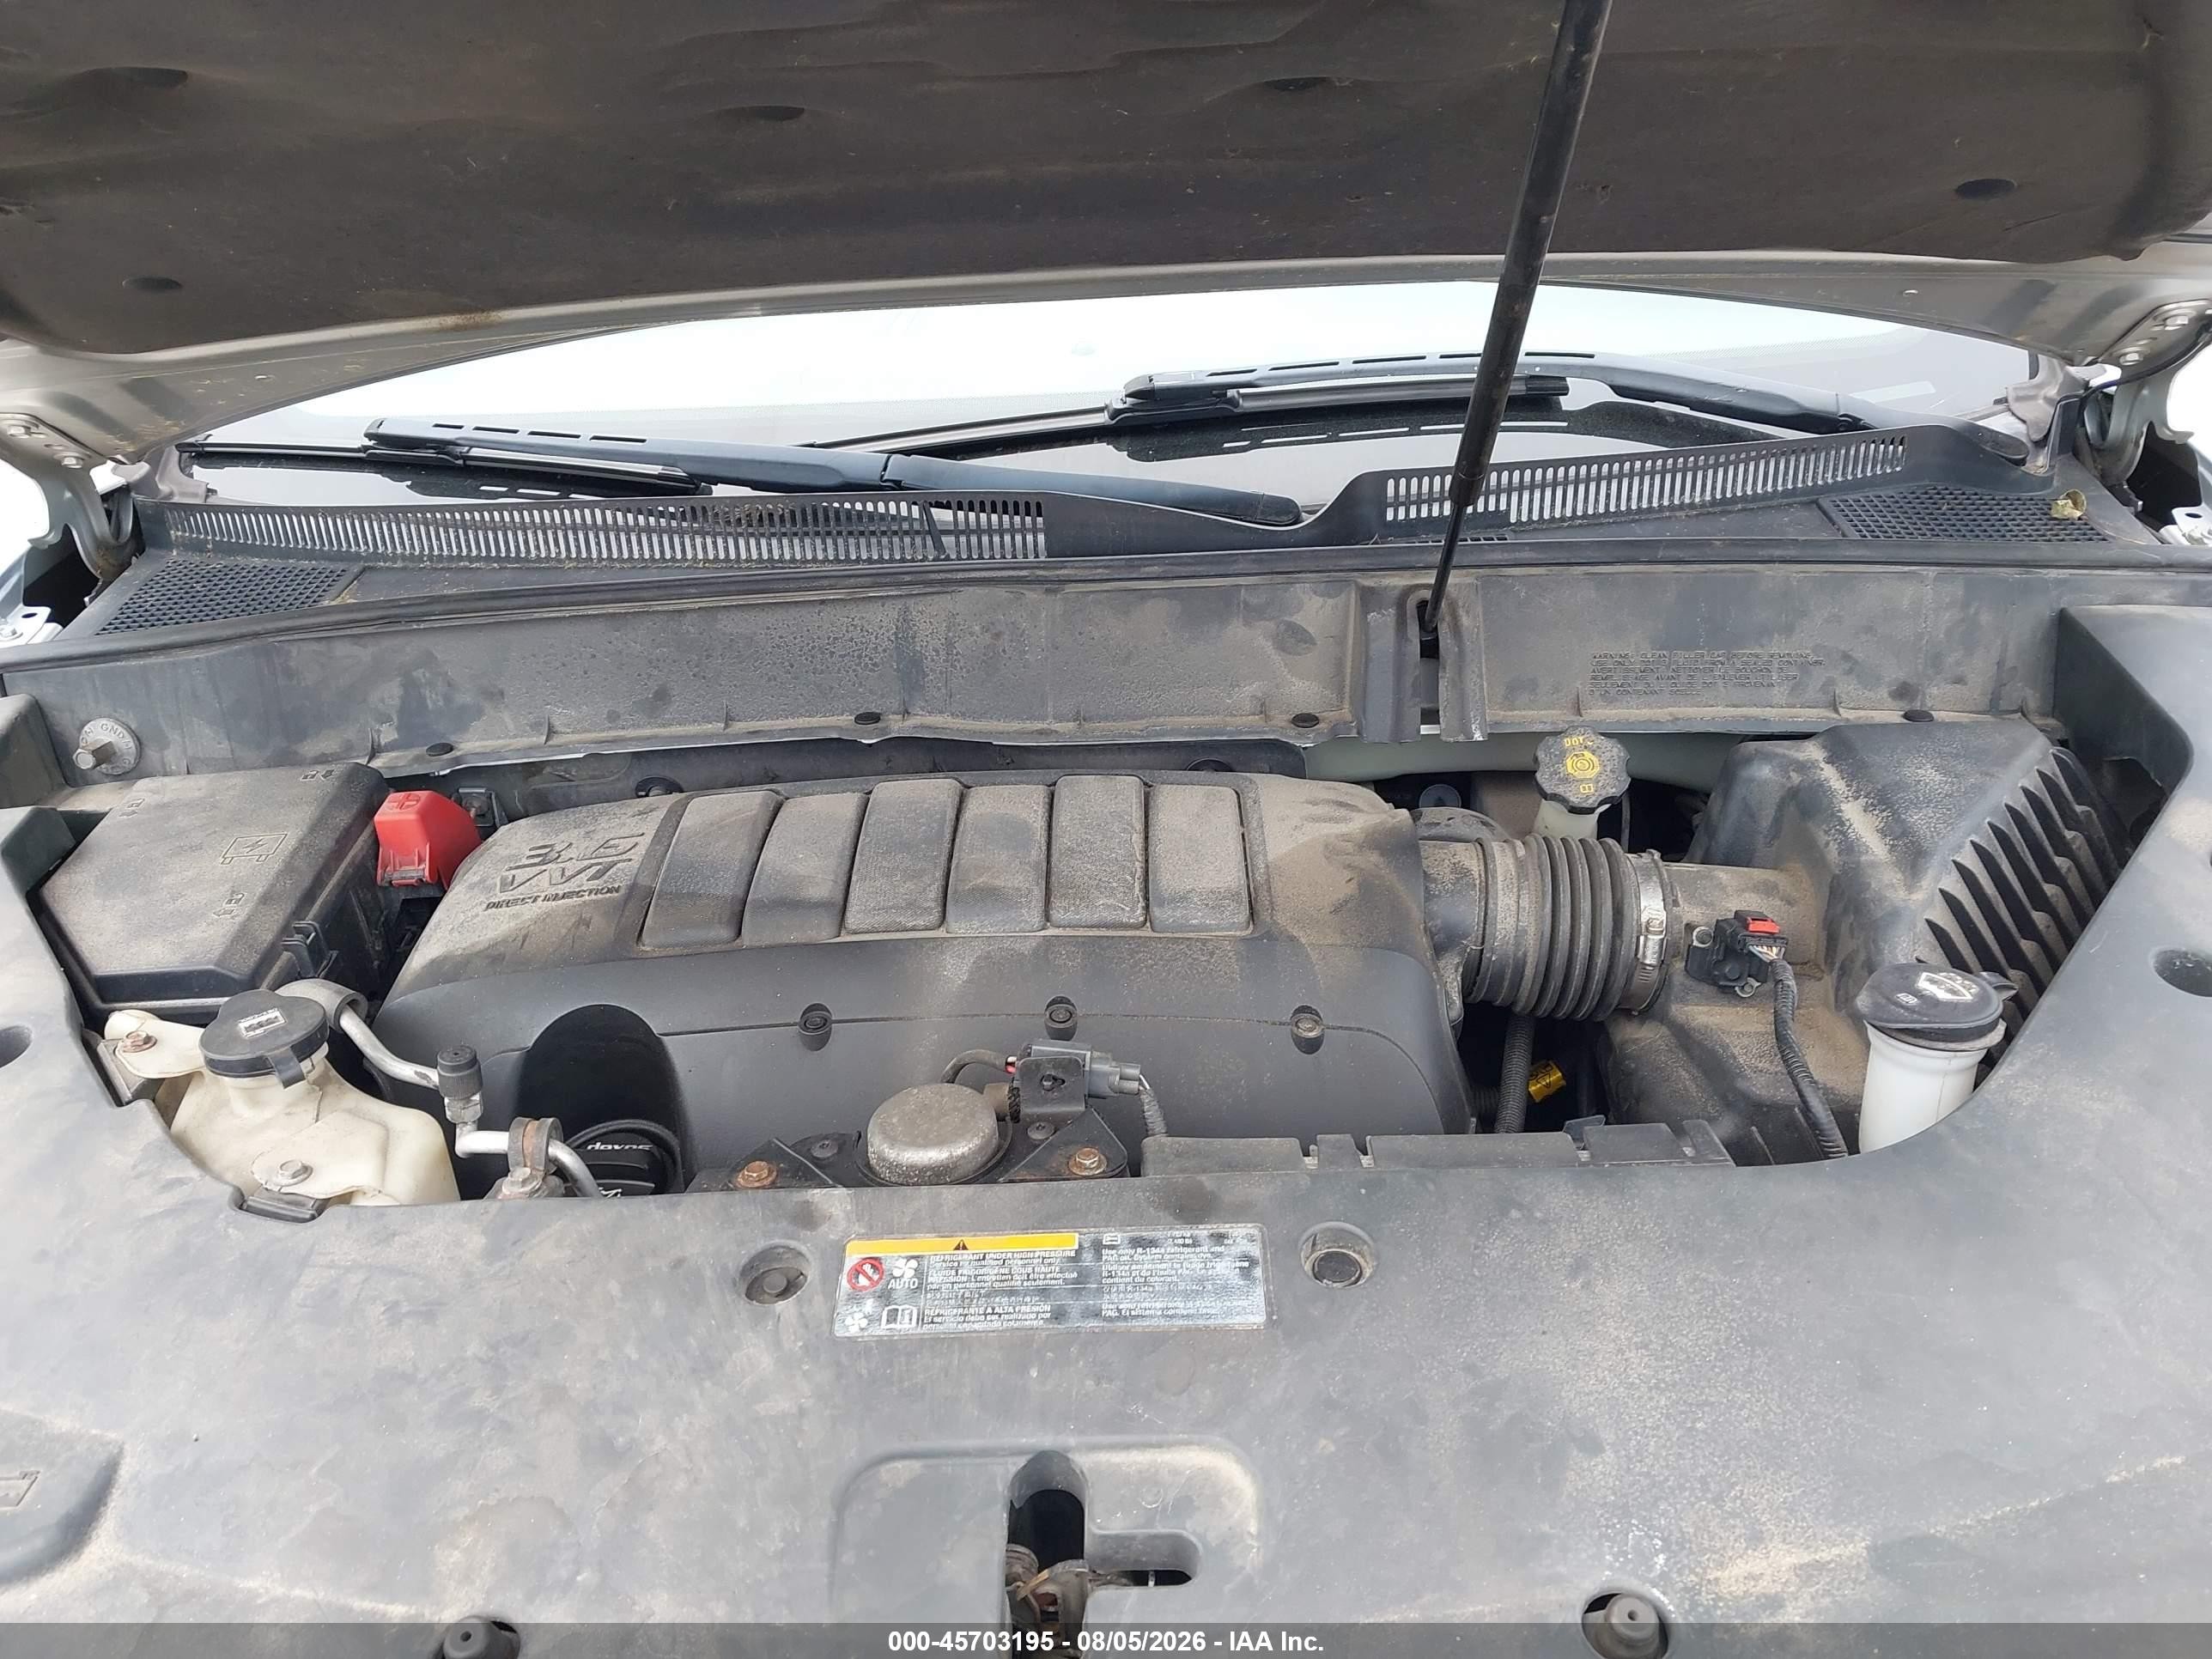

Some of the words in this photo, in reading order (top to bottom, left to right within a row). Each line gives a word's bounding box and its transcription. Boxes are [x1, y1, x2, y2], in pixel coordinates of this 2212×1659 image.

[1565, 737, 1584, 746] DOT
[499, 859, 633, 894] VVT
[484, 895, 541, 911] DIRECT
[541, 885, 621, 902] INJECTION
[888, 1279, 918, 1289] AUTO
